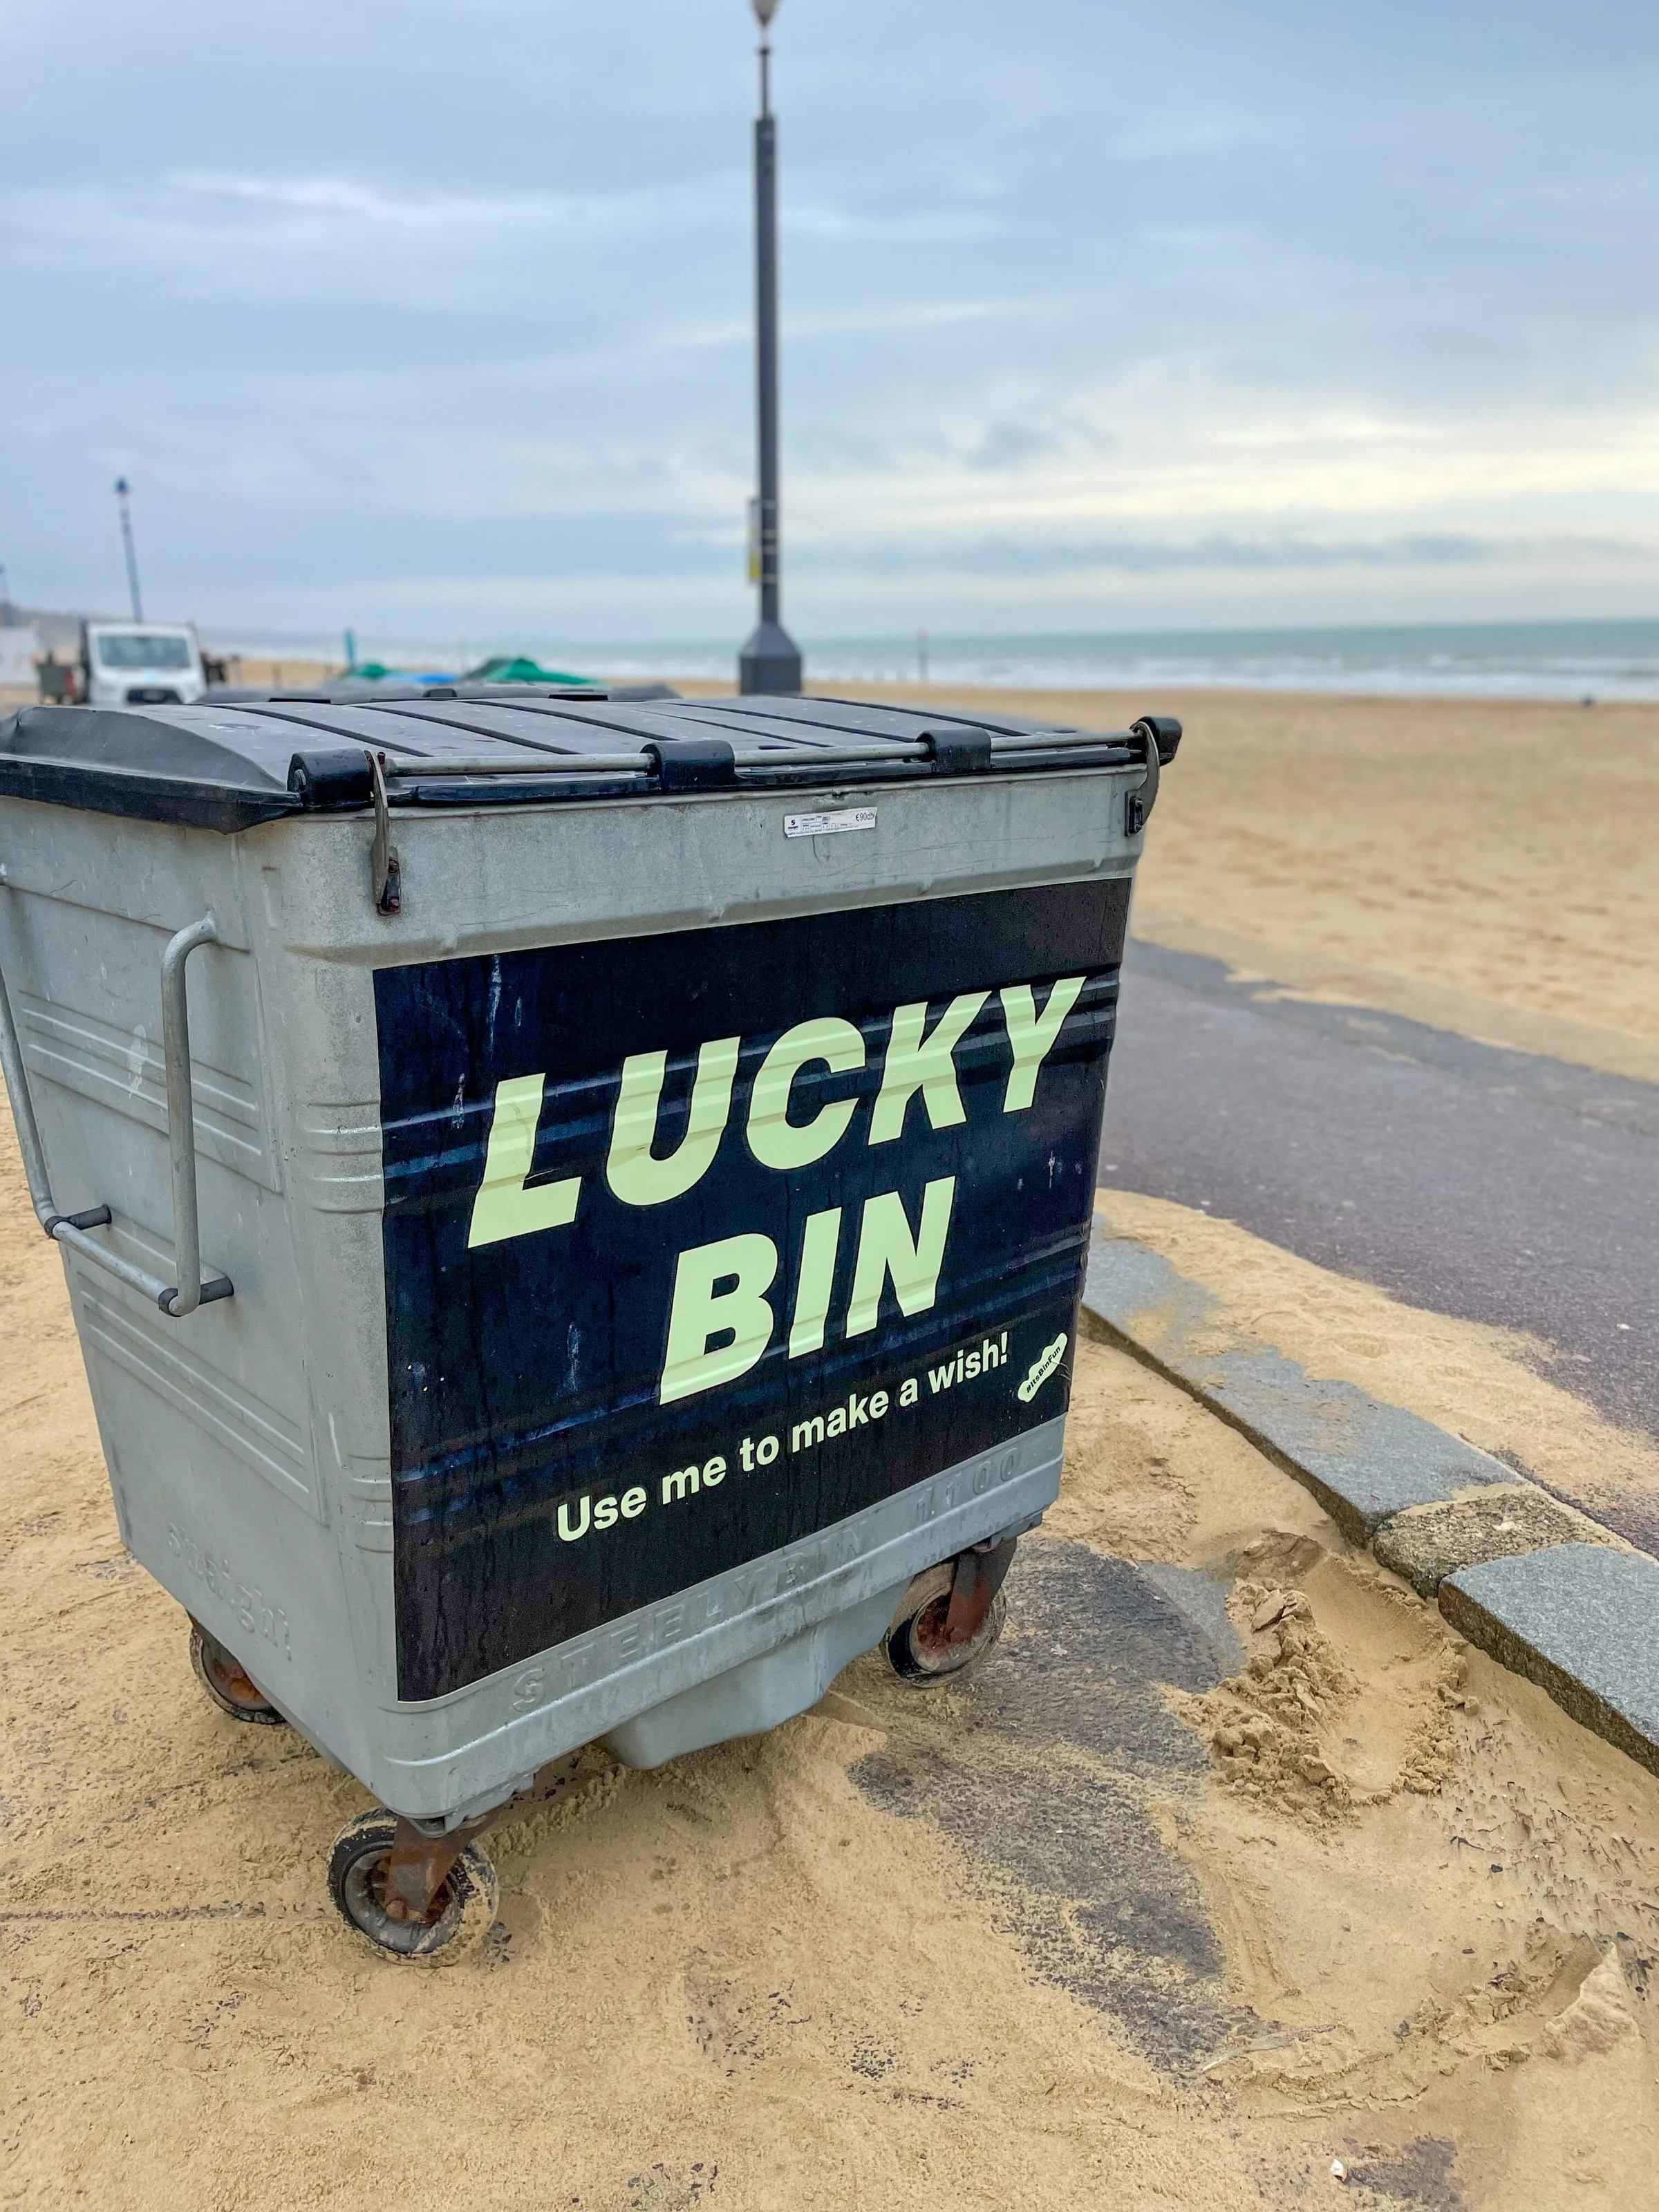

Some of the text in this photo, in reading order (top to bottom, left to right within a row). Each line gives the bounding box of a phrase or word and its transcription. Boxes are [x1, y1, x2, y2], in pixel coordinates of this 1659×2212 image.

[467, 976, 1087, 1248] LUCKY
[659, 1176, 956, 1405] BIN
[1026, 1346, 1061, 1394] #ItsBinFun
[556, 1331, 1009, 1541] Use me to make a wish!
[915, 1447, 1020, 1522] 1100
